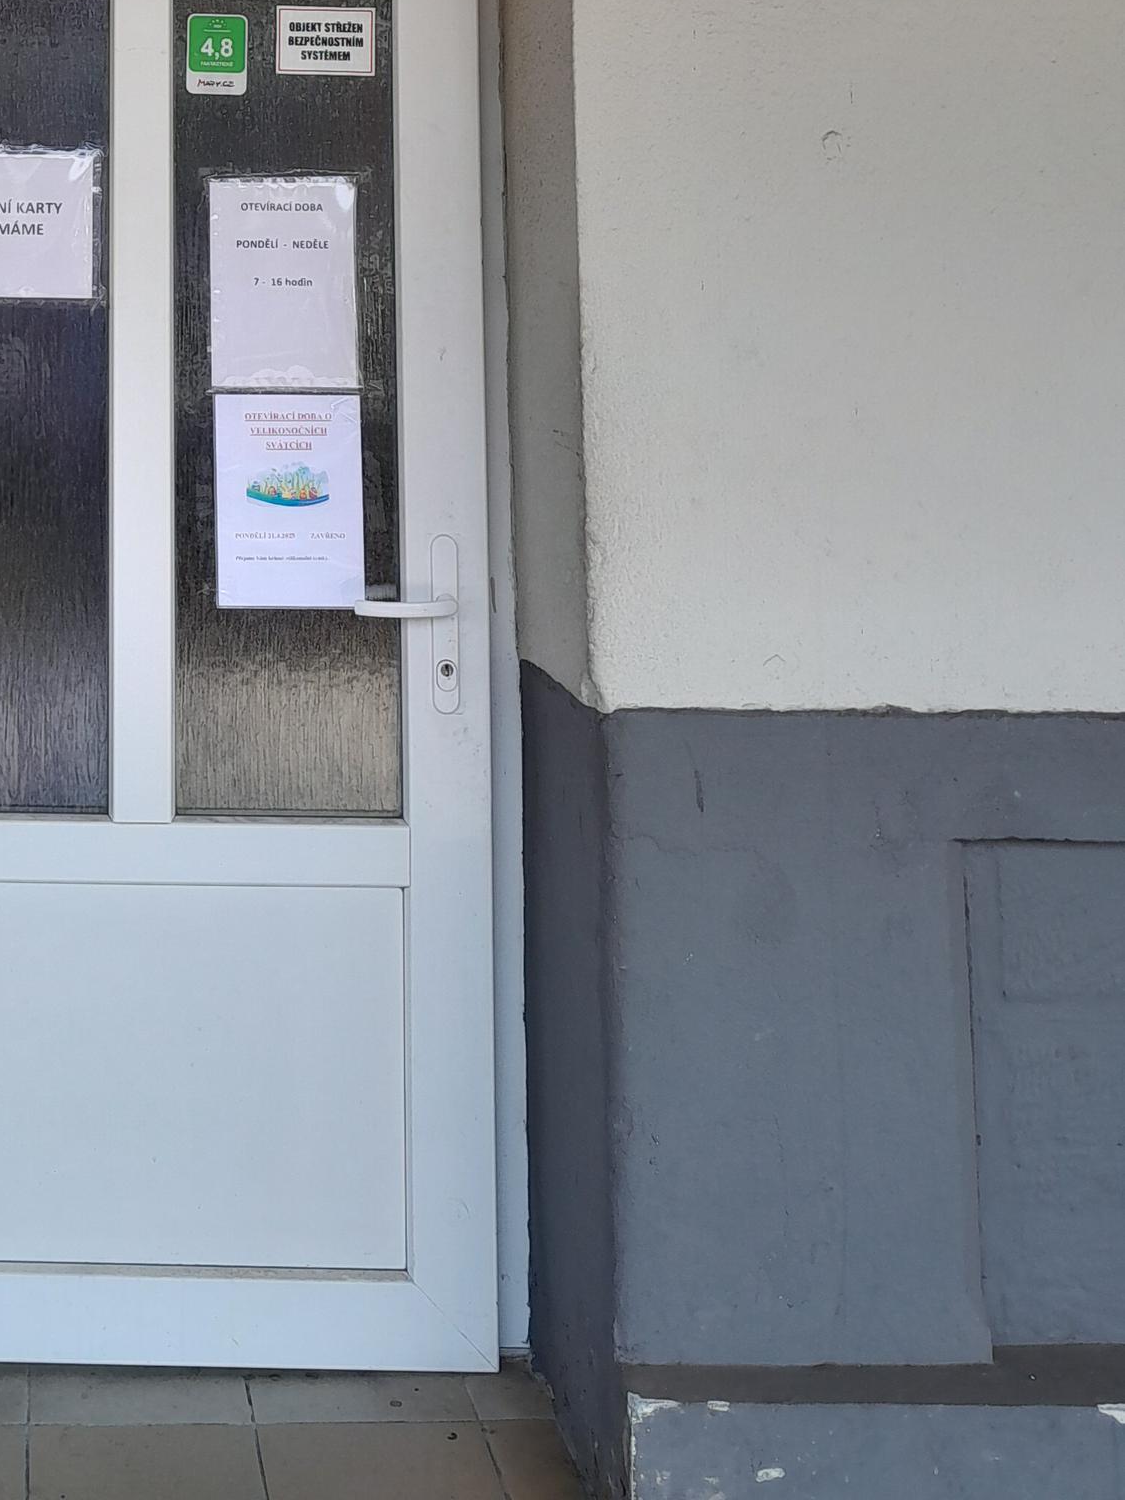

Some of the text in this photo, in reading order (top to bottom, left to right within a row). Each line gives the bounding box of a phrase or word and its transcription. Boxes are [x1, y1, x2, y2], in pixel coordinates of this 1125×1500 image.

[288, 20, 364, 34] OBJEKT STŘEŽEN
[287, 34, 364, 48] BEZPEČNOSTNÍM
[199, 37, 234, 60] 4,8
[300, 48, 351, 62] SYSTÉMEM
[16, 201, 63, 215] KARTY
[240, 200, 324, 212] OTEVÍRACÍ DOBA
[236, 237, 279, 250] PONDĚLÍ
[292, 238, 330, 250] NEDĚLE
[253, 277, 260, 287] 7
[271, 277, 283, 287] 16
[285, 277, 313, 287] hodin
